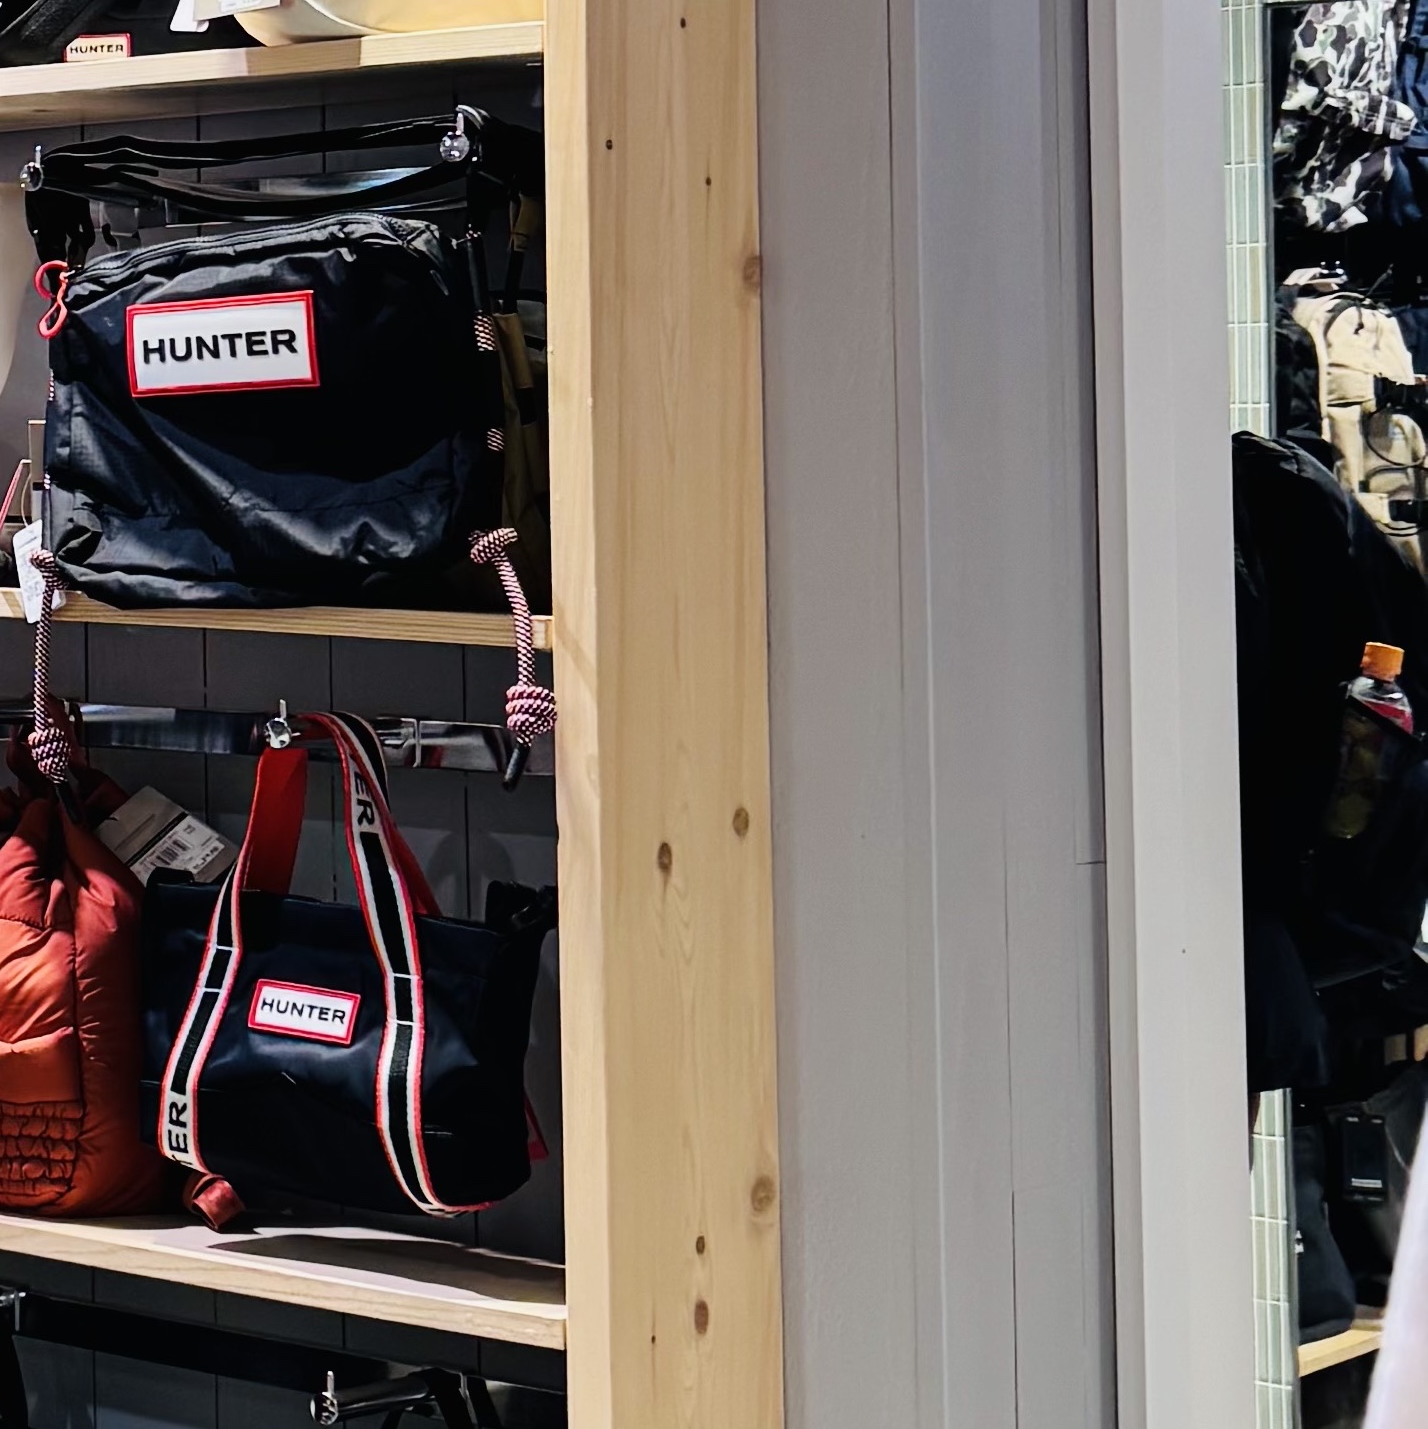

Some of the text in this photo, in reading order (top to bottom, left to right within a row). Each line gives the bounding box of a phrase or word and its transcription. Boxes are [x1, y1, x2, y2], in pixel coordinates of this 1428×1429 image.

[69, 44, 124, 56] HUNTER
[142, 329, 298, 365] HUNTER
[260, 997, 348, 1026] HUNTER
